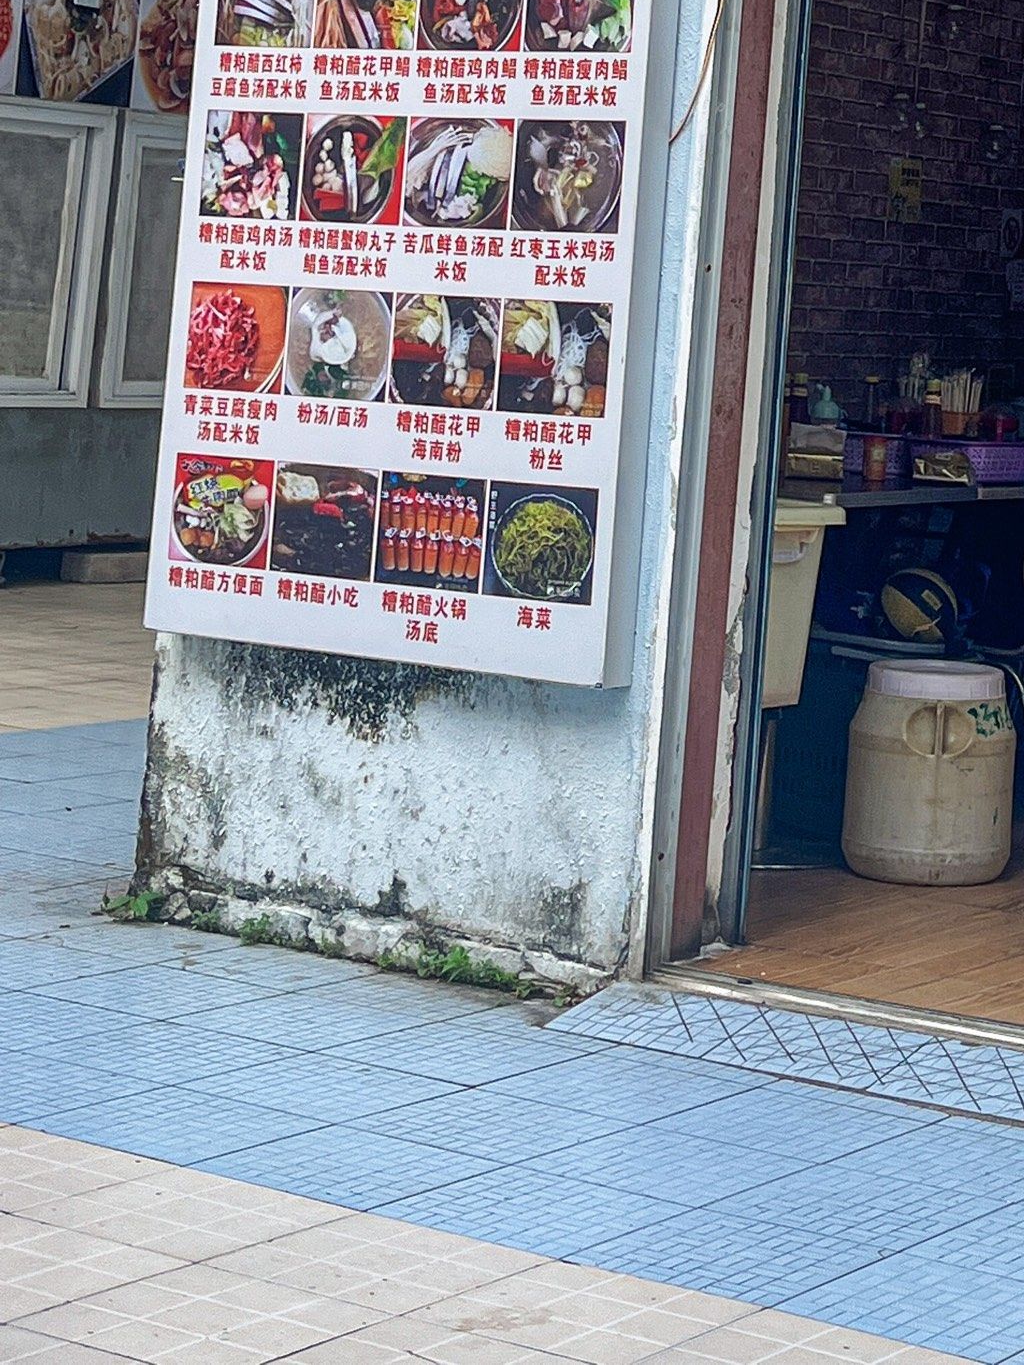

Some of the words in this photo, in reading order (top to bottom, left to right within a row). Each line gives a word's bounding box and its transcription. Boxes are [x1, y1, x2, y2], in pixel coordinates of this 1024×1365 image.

[220, 51, 303, 73] 糟粕醋西红柿
[210, 77, 307, 99] 豆腐鱼汤配米饭
[319, 79, 400, 102] 鱼汤配米饭
[423, 83, 506, 105] 鱼汤配米饭
[530, 85, 618, 106] 鱼汤配米饭
[199, 221, 293, 247] 糟粕醋鸡肉汤
[404, 233, 504, 257] 苦瓜鲜鱼汤配
[220, 249, 267, 271] 配米饭
[510, 237, 615, 261] 红枣玉米鸡汤
[434, 259, 467, 282] 米饭
[534, 265, 586, 288] 配米饭
[184, 394, 278, 421] 青菜豆腐瘦肉
[297, 401, 368, 429] 粉汤/面汤
[197, 421, 260, 445] 汤配米饭
[396, 410, 481, 437] 糟粕醋花甲
[505, 418, 592, 446] 糟粕醋花甲
[411, 438, 462, 463] 海南粉
[529, 447, 563, 471] 粉丝
[168, 565, 264, 597] 糟粕醋方便面
[277, 577, 360, 609] 糟粕醋小吃
[382, 589, 467, 621] 糟粕醋火锅
[516, 605, 552, 631] 海菜
[405, 619, 439, 644] 汤底
